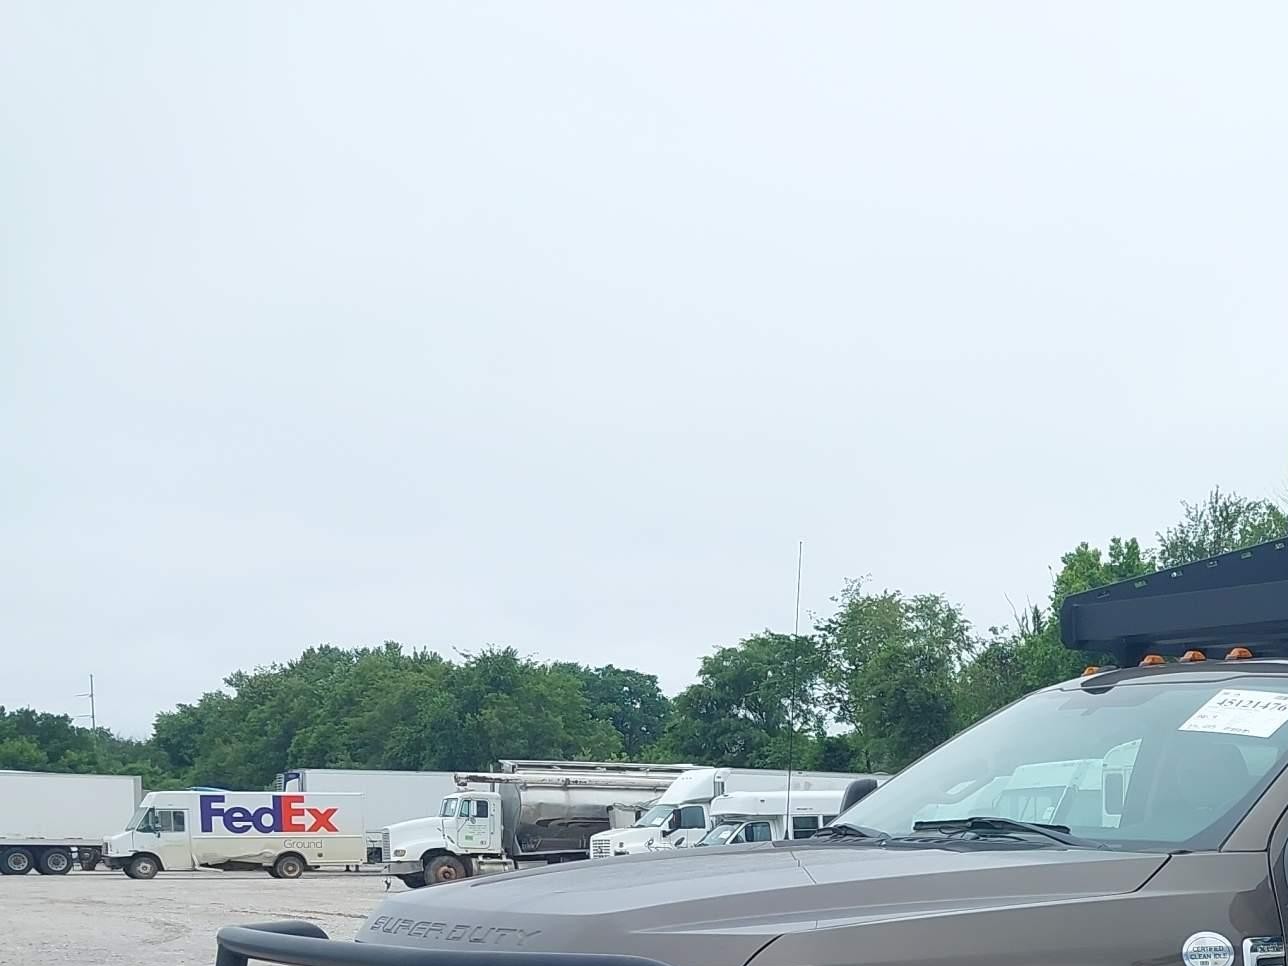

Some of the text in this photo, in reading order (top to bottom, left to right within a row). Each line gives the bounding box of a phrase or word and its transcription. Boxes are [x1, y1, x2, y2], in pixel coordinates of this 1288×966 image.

[1217, 698, 1288, 712] 45121476
[200, 794, 340, 834] FedEx
[283, 839, 323, 850] Ground
[370, 914, 542, 946] SUPER DUTY
[1192, 945, 1224, 953] CERTIFIED
